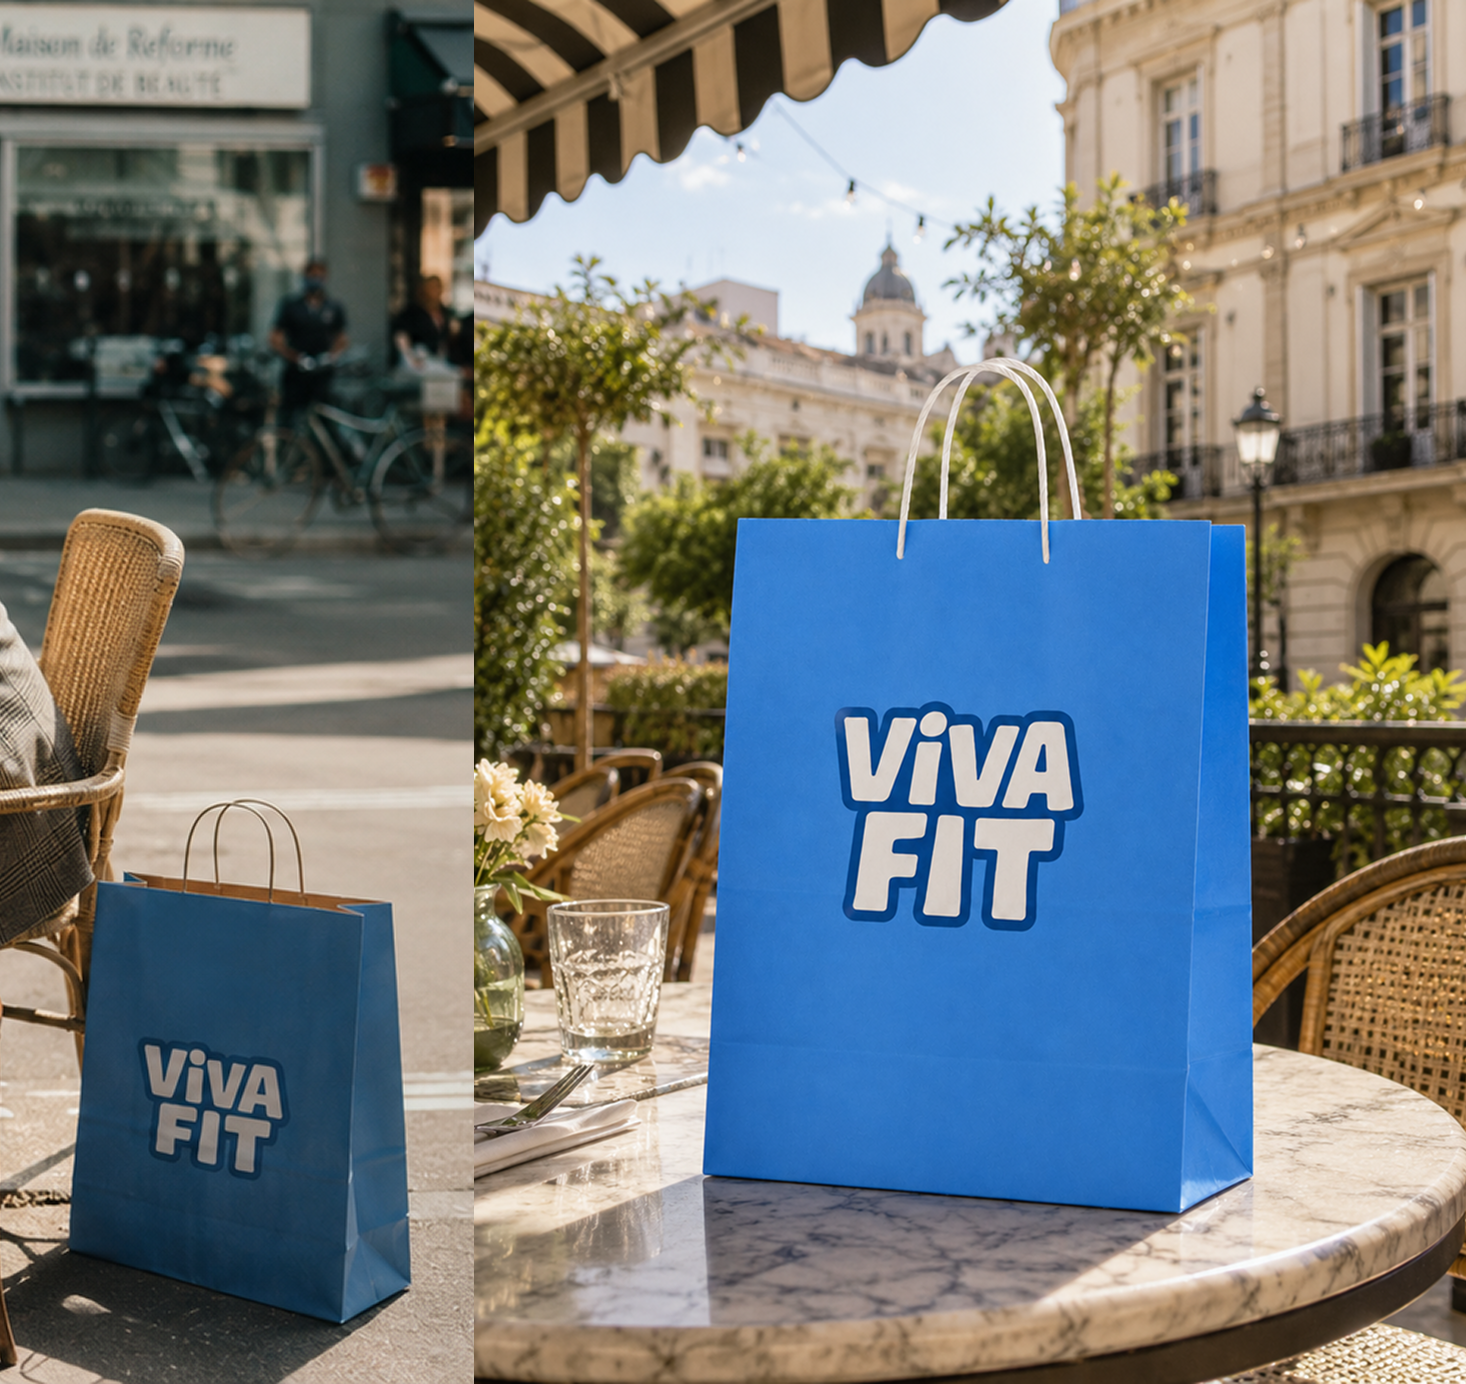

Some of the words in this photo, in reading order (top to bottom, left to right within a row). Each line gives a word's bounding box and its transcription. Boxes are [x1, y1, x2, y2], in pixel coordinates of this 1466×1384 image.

[88, 24, 118, 58] de
[95, 70, 124, 97] DE
[852, 811, 1055, 921] FIT
[155, 1102, 271, 1173] FIT
